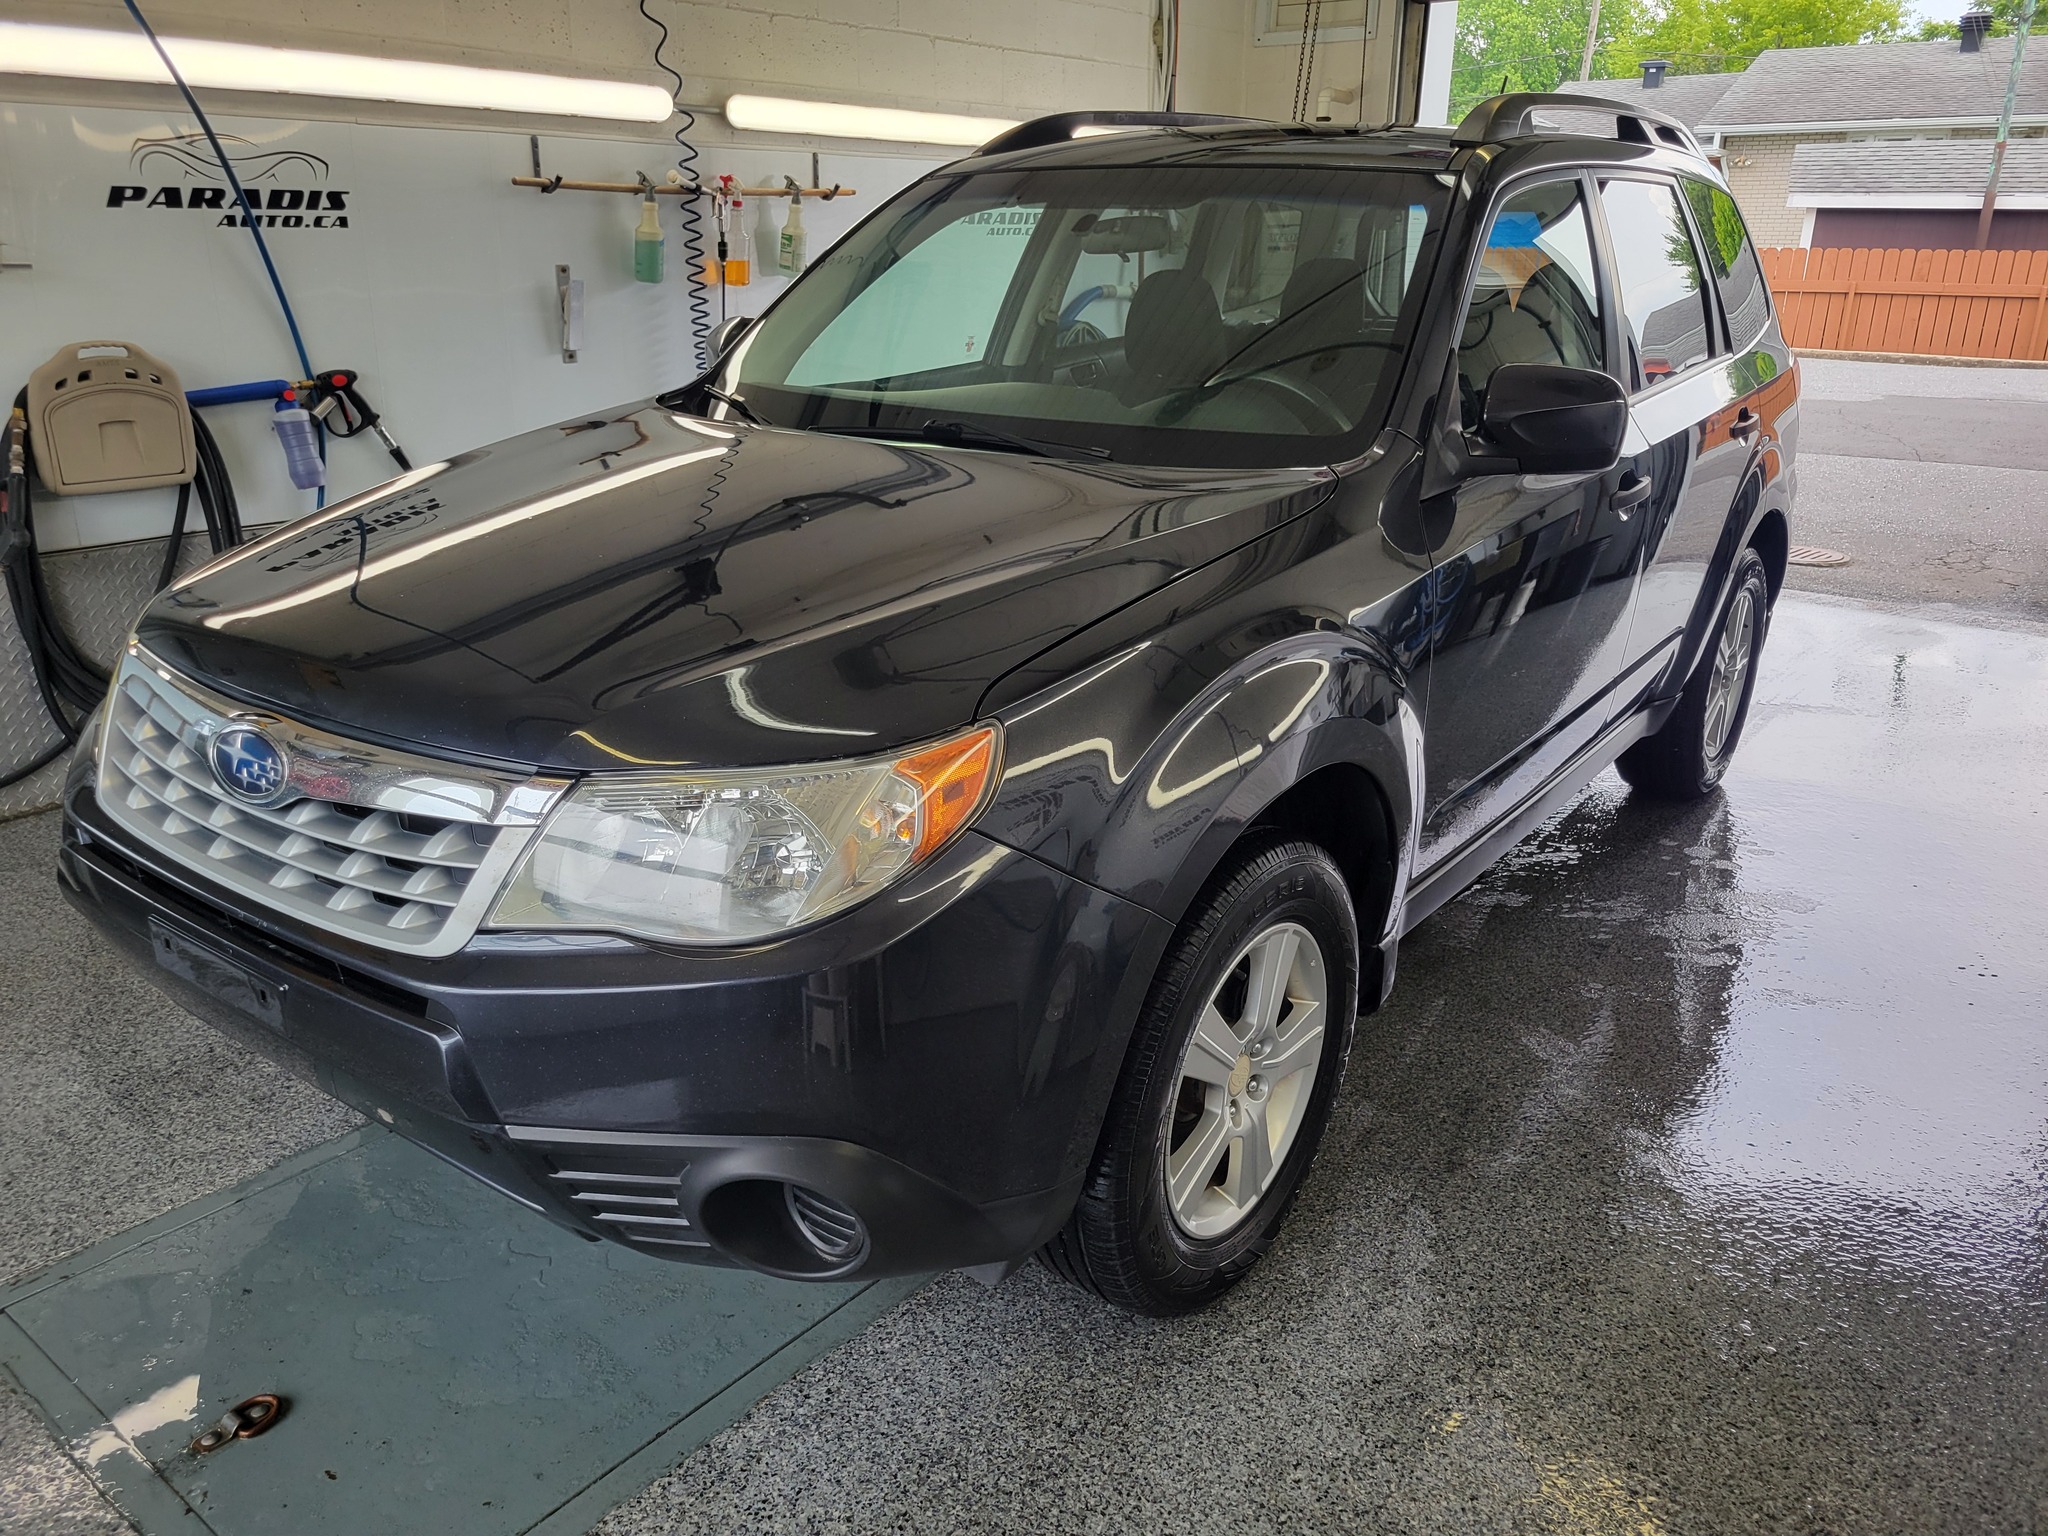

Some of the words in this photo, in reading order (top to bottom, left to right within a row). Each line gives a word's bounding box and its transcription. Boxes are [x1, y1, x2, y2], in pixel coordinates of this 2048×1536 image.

[106, 185, 350, 211] PARADIS
[216, 214, 349, 228] AUTO.CA
[961, 212, 1043, 225] ARADIS
[986, 227, 1034, 236] AUTO.C
